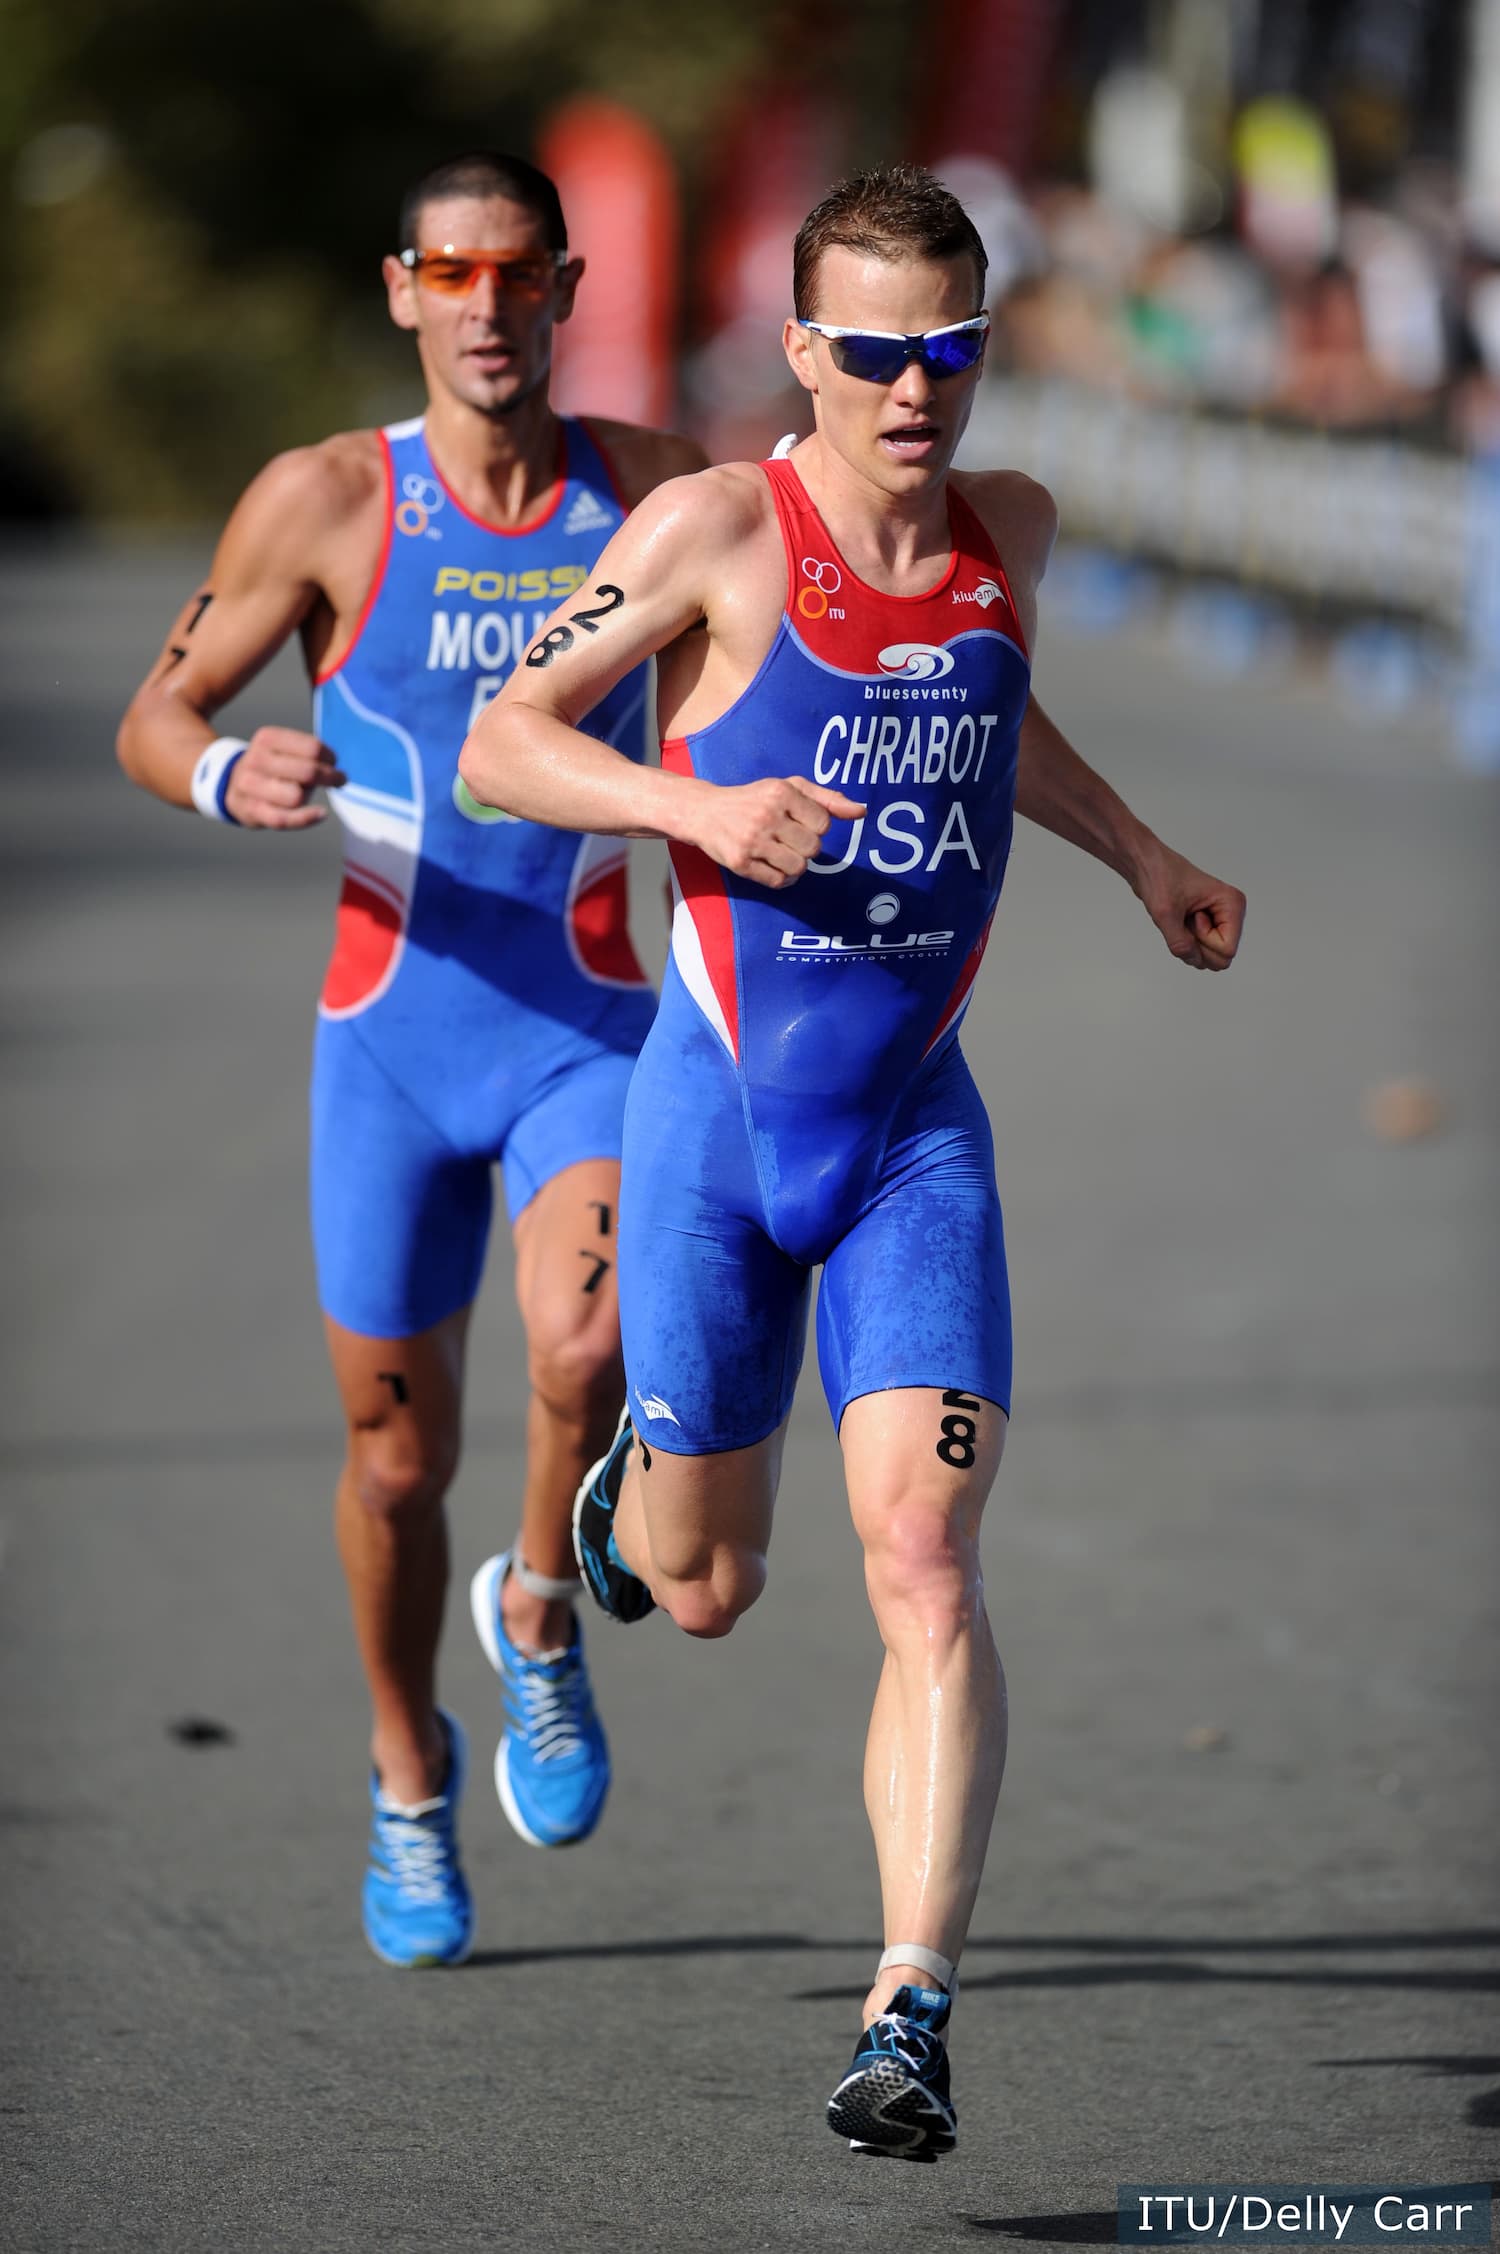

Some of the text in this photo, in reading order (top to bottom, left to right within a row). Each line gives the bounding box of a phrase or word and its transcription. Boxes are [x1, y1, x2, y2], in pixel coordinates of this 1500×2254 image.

[828, 607, 846, 620] ITU
[426, 610, 553, 672] MOU
[864, 685, 968, 702] blueseventy
[813, 714, 998, 785] CHRABOT
[775, 951, 949, 963] COMPETITION CYCLES
